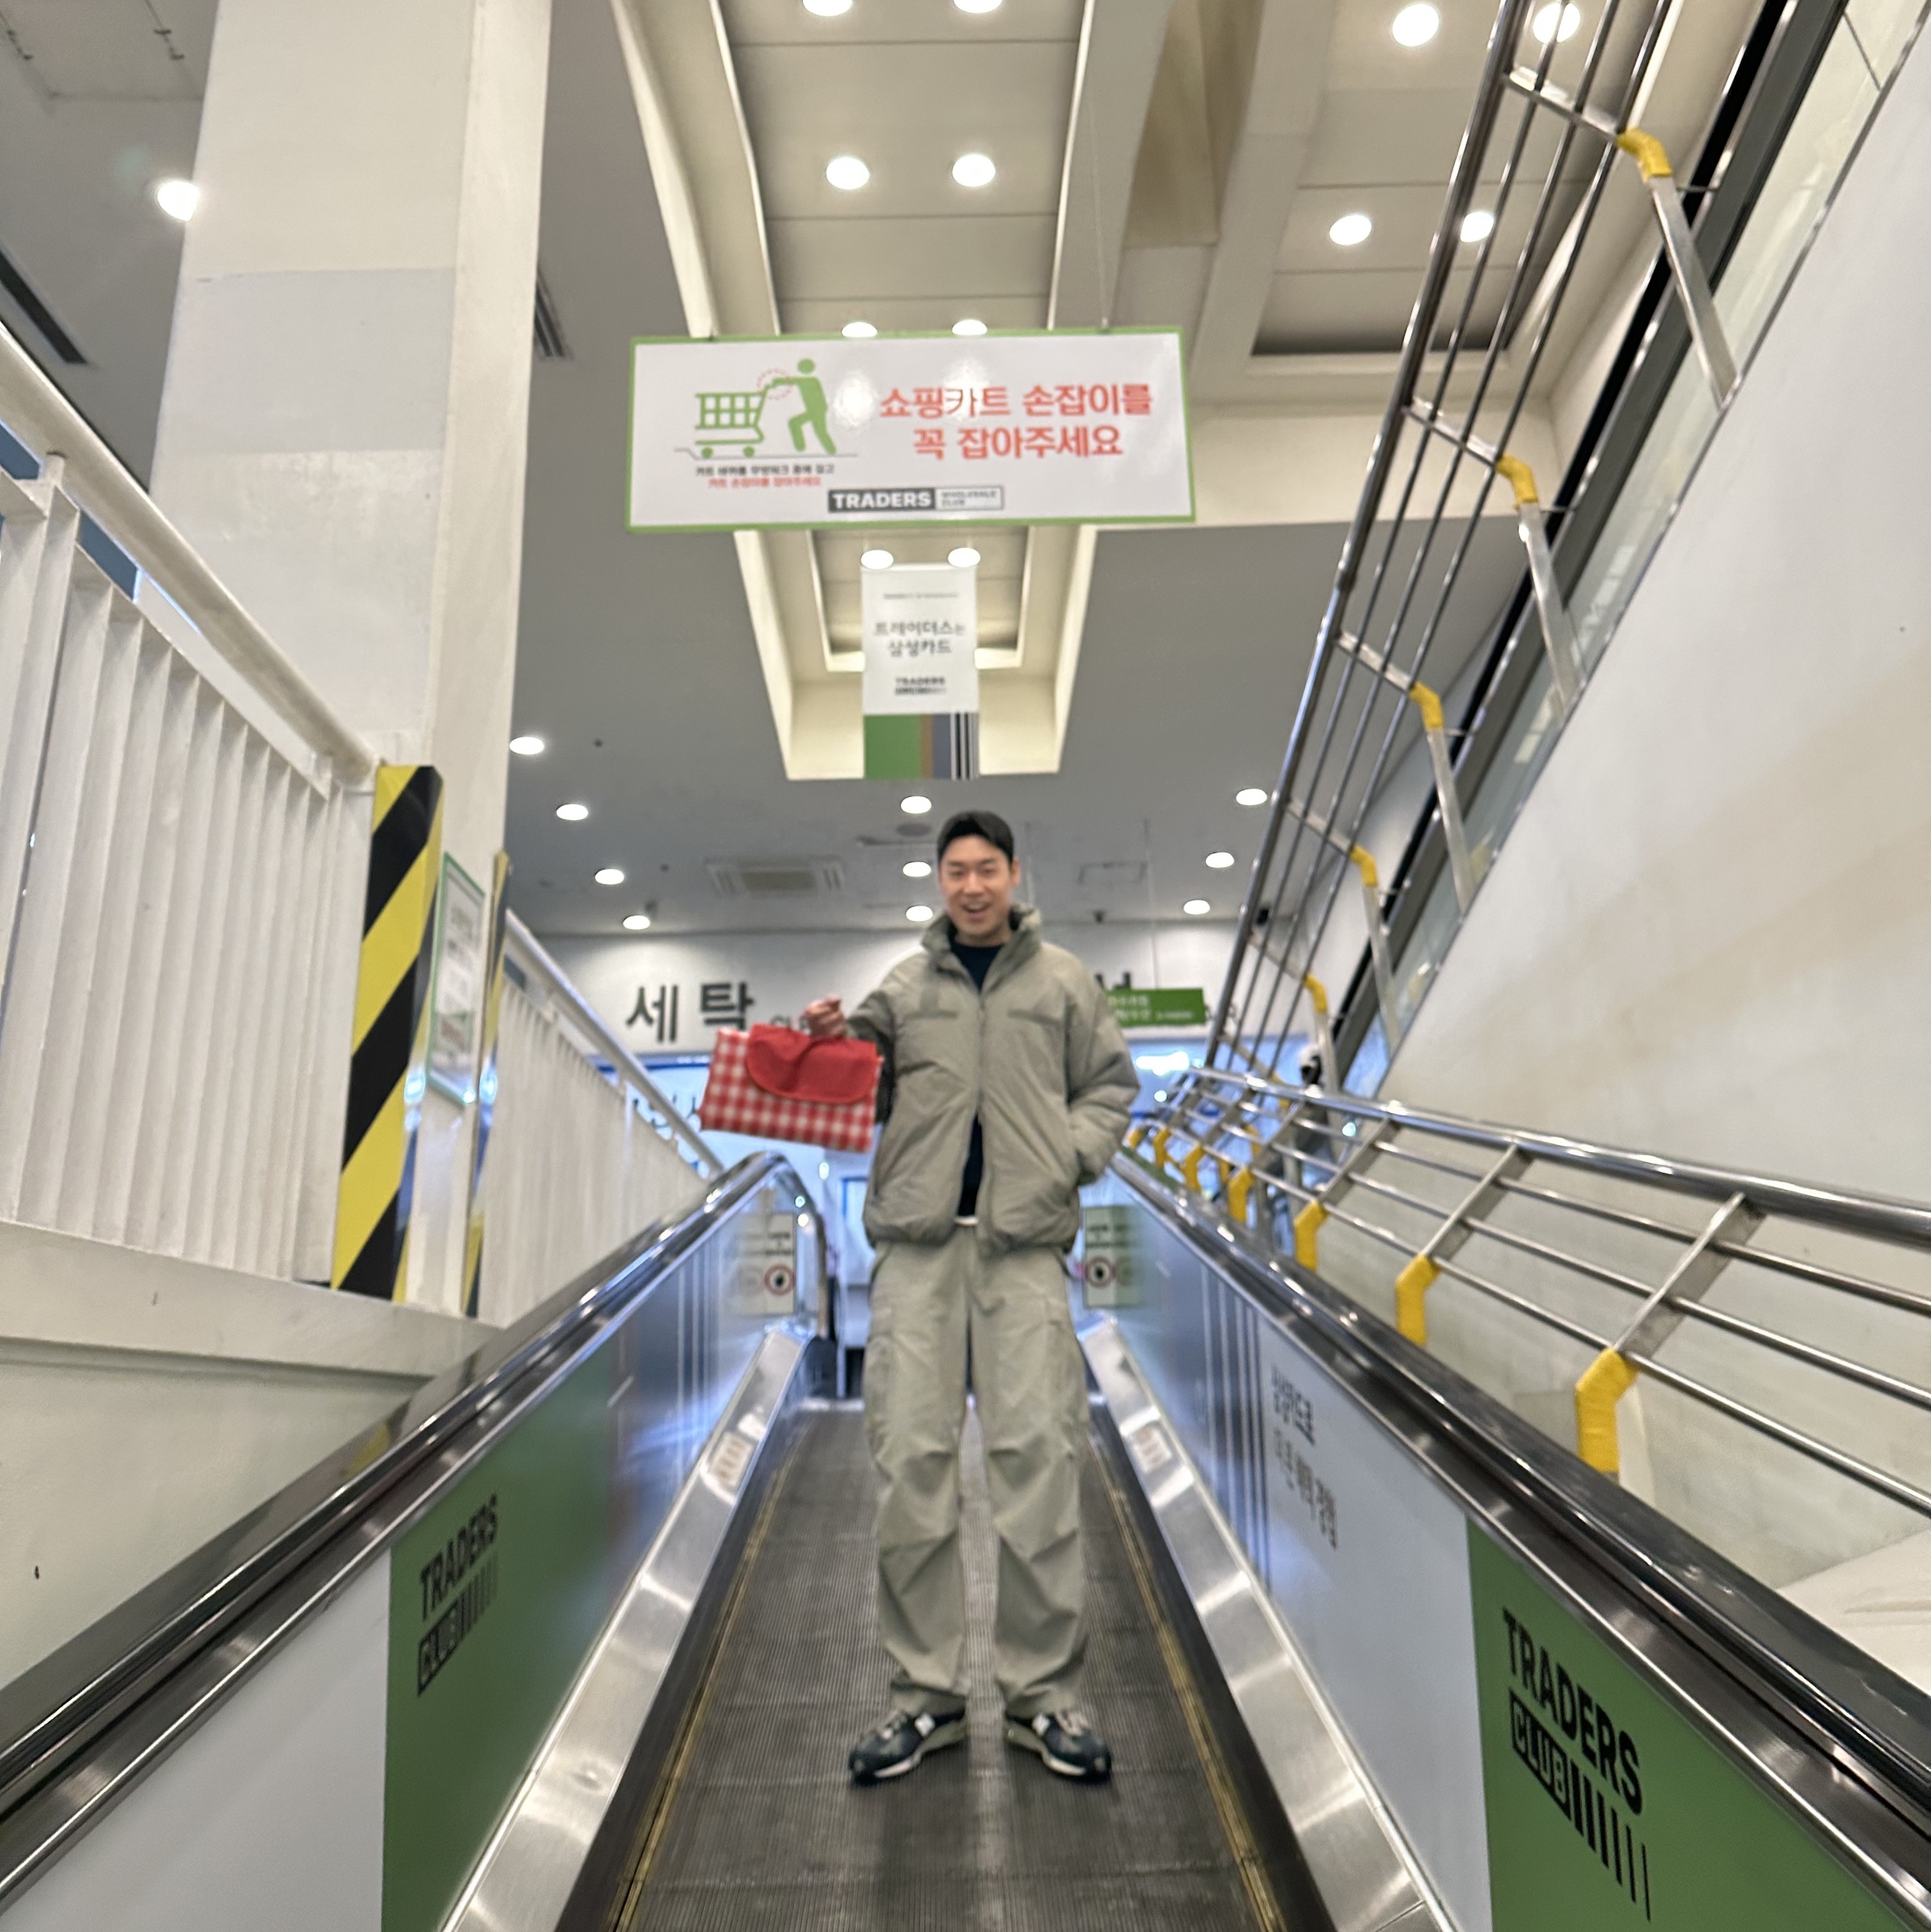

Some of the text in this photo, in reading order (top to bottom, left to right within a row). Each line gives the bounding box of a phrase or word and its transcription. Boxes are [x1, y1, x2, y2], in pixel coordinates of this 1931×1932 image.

[880, 384, 1152, 418] 쇼핑카트 손잡이를
[913, 425, 1123, 460] 꼭 잡아주세요
[832, 491, 931, 508] TRADERS
[420, 1492, 498, 1623] TRADERS
[1502, 1606, 1643, 1816] TRADERS
